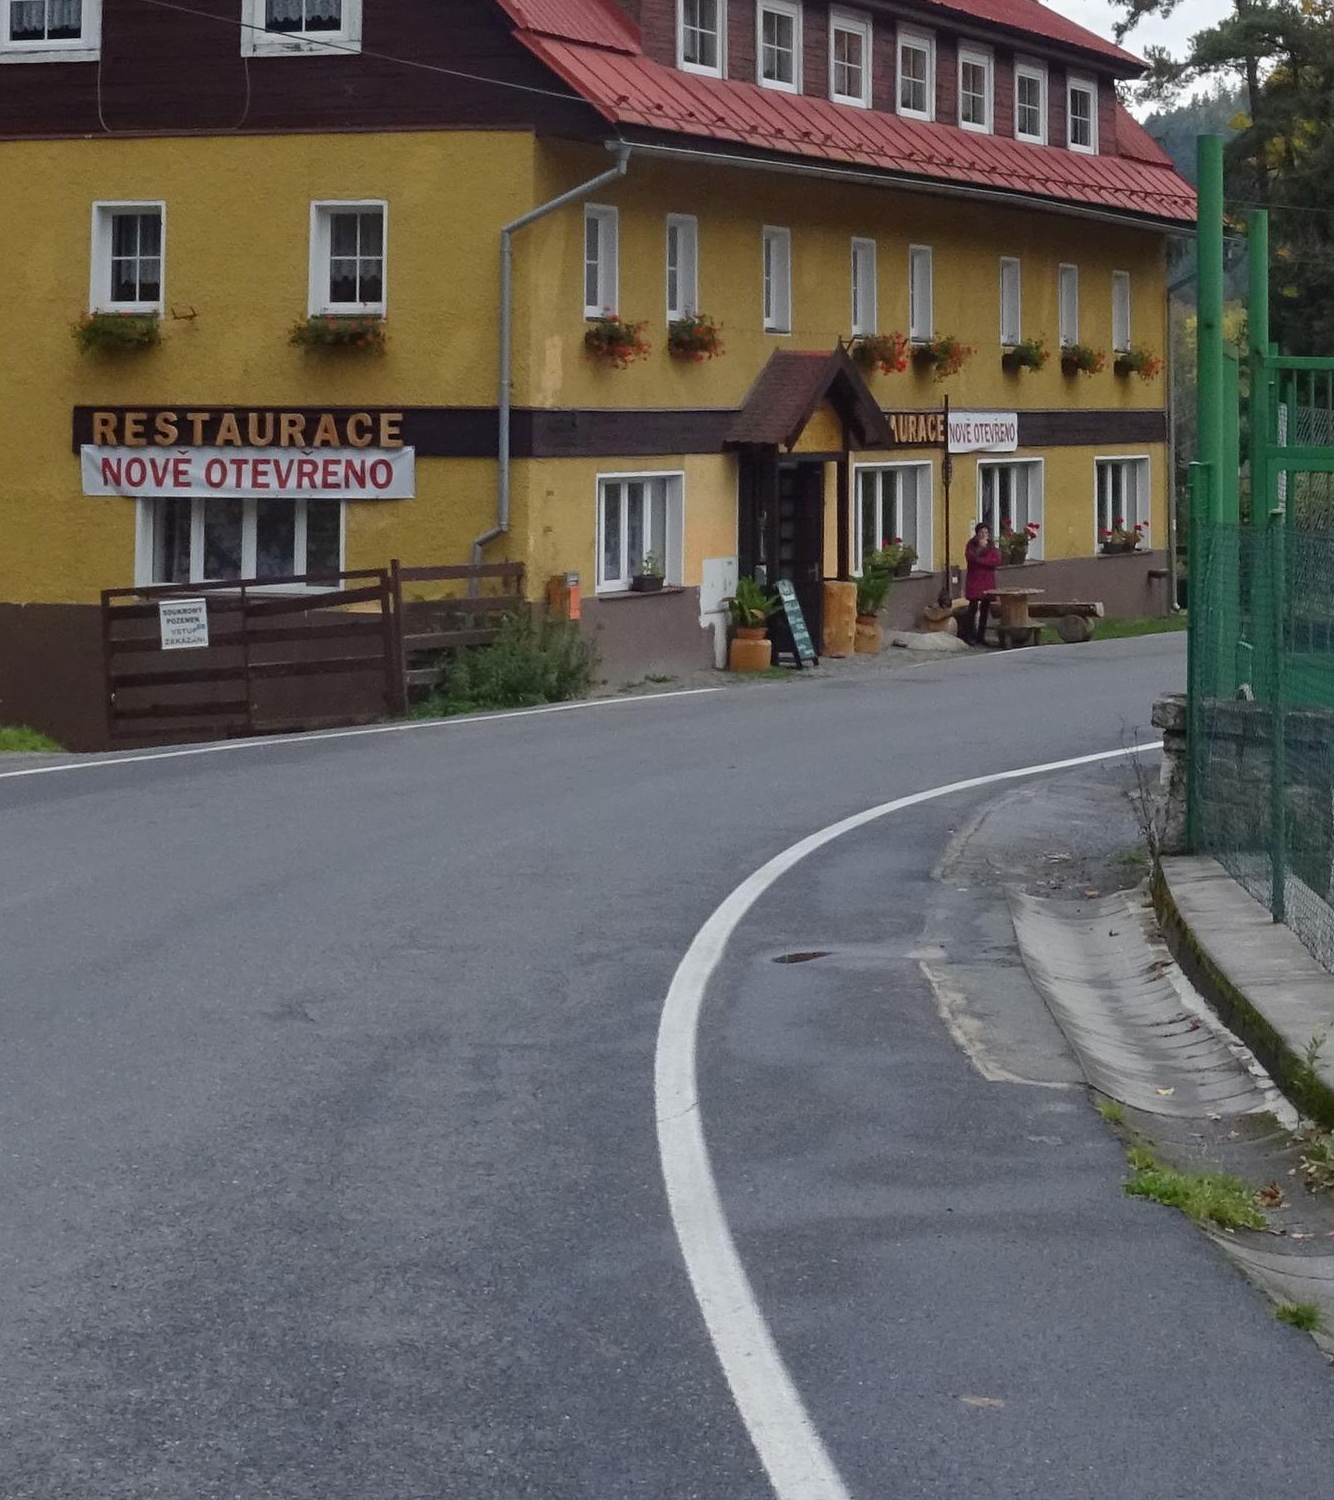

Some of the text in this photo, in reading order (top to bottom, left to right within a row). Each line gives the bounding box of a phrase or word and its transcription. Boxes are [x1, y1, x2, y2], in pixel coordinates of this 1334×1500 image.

[93, 412, 404, 447] RESTAURACE
[889, 414, 945, 443] AURACE
[974, 418, 1015, 443] OTEVŘENO
[100, 450, 393, 489] NOVĚ OTEVŘENO
